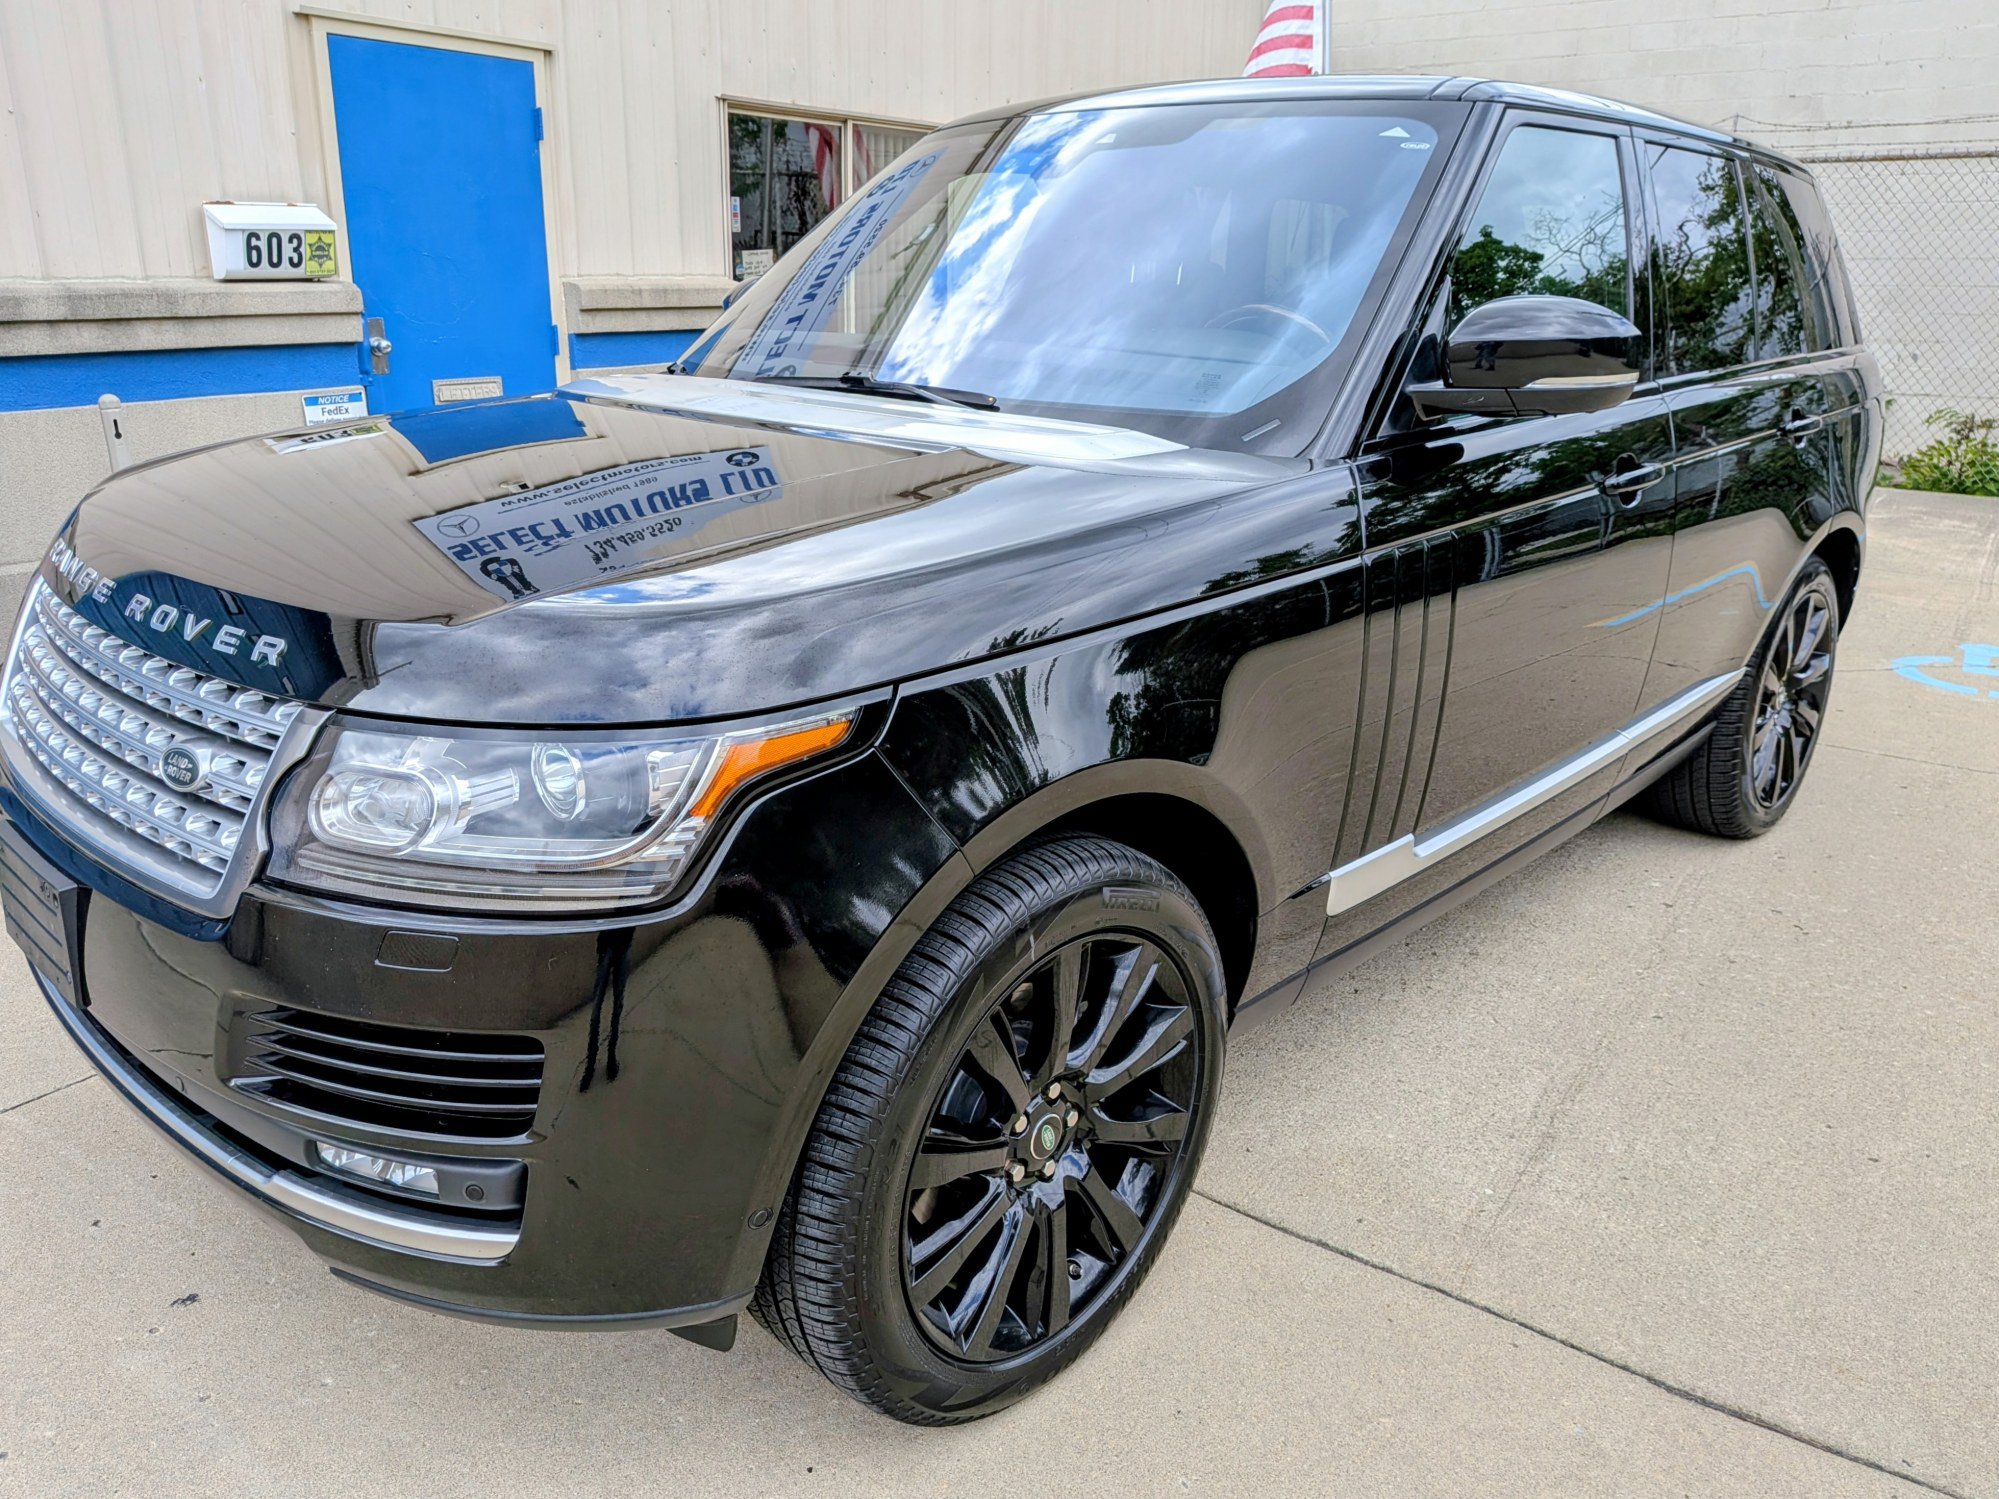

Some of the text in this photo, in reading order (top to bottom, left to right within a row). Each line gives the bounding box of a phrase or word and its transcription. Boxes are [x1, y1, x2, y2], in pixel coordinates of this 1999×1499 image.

[245, 231, 304, 269] 603
[318, 395, 350, 405] NOTICE
[321, 406, 350, 416] FedEx
[50, 537, 288, 667] RANGE ROVER
[167, 765, 192, 783] ROVER
[1103, 886, 1161, 913] PIRELLI
